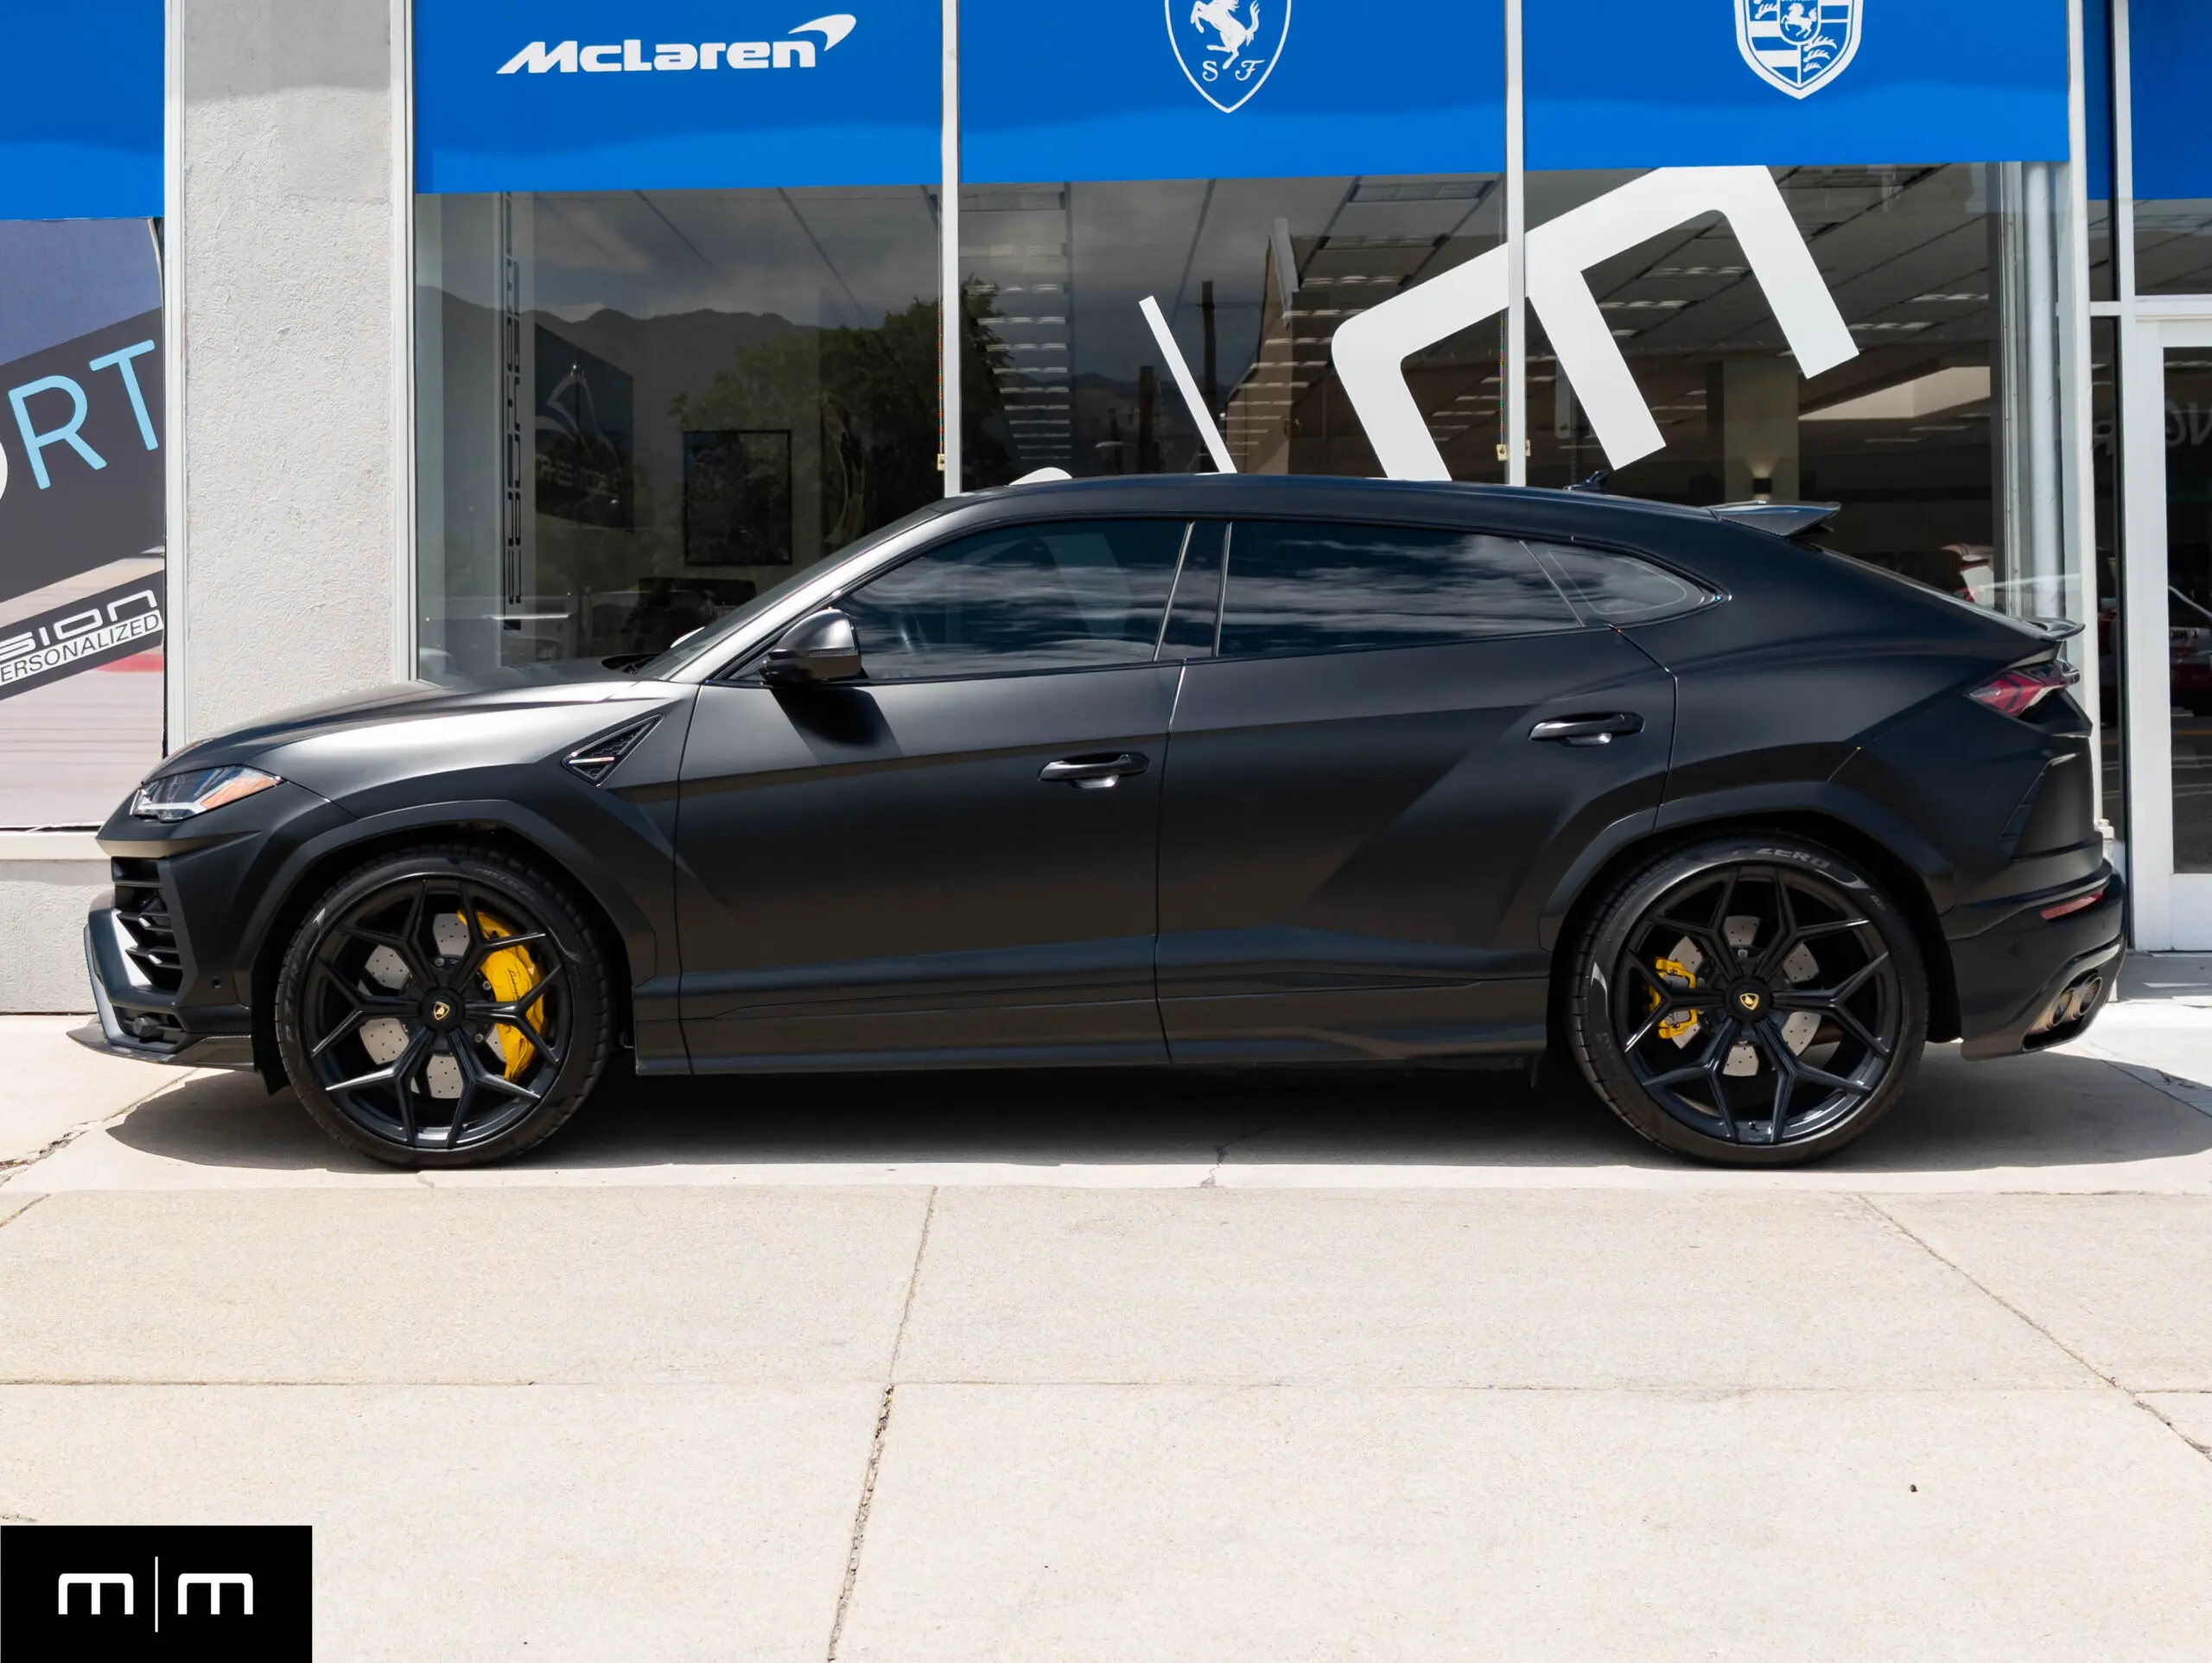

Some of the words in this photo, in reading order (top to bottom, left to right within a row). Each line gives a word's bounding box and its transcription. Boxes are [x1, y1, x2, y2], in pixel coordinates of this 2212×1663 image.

[496, 39, 816, 74] McLaren
[1202, 60, 1219, 82] S
[1235, 59, 1266, 81] F
[0, 339, 159, 501] RT
[0, 613, 160, 682] ERSONALIZED
